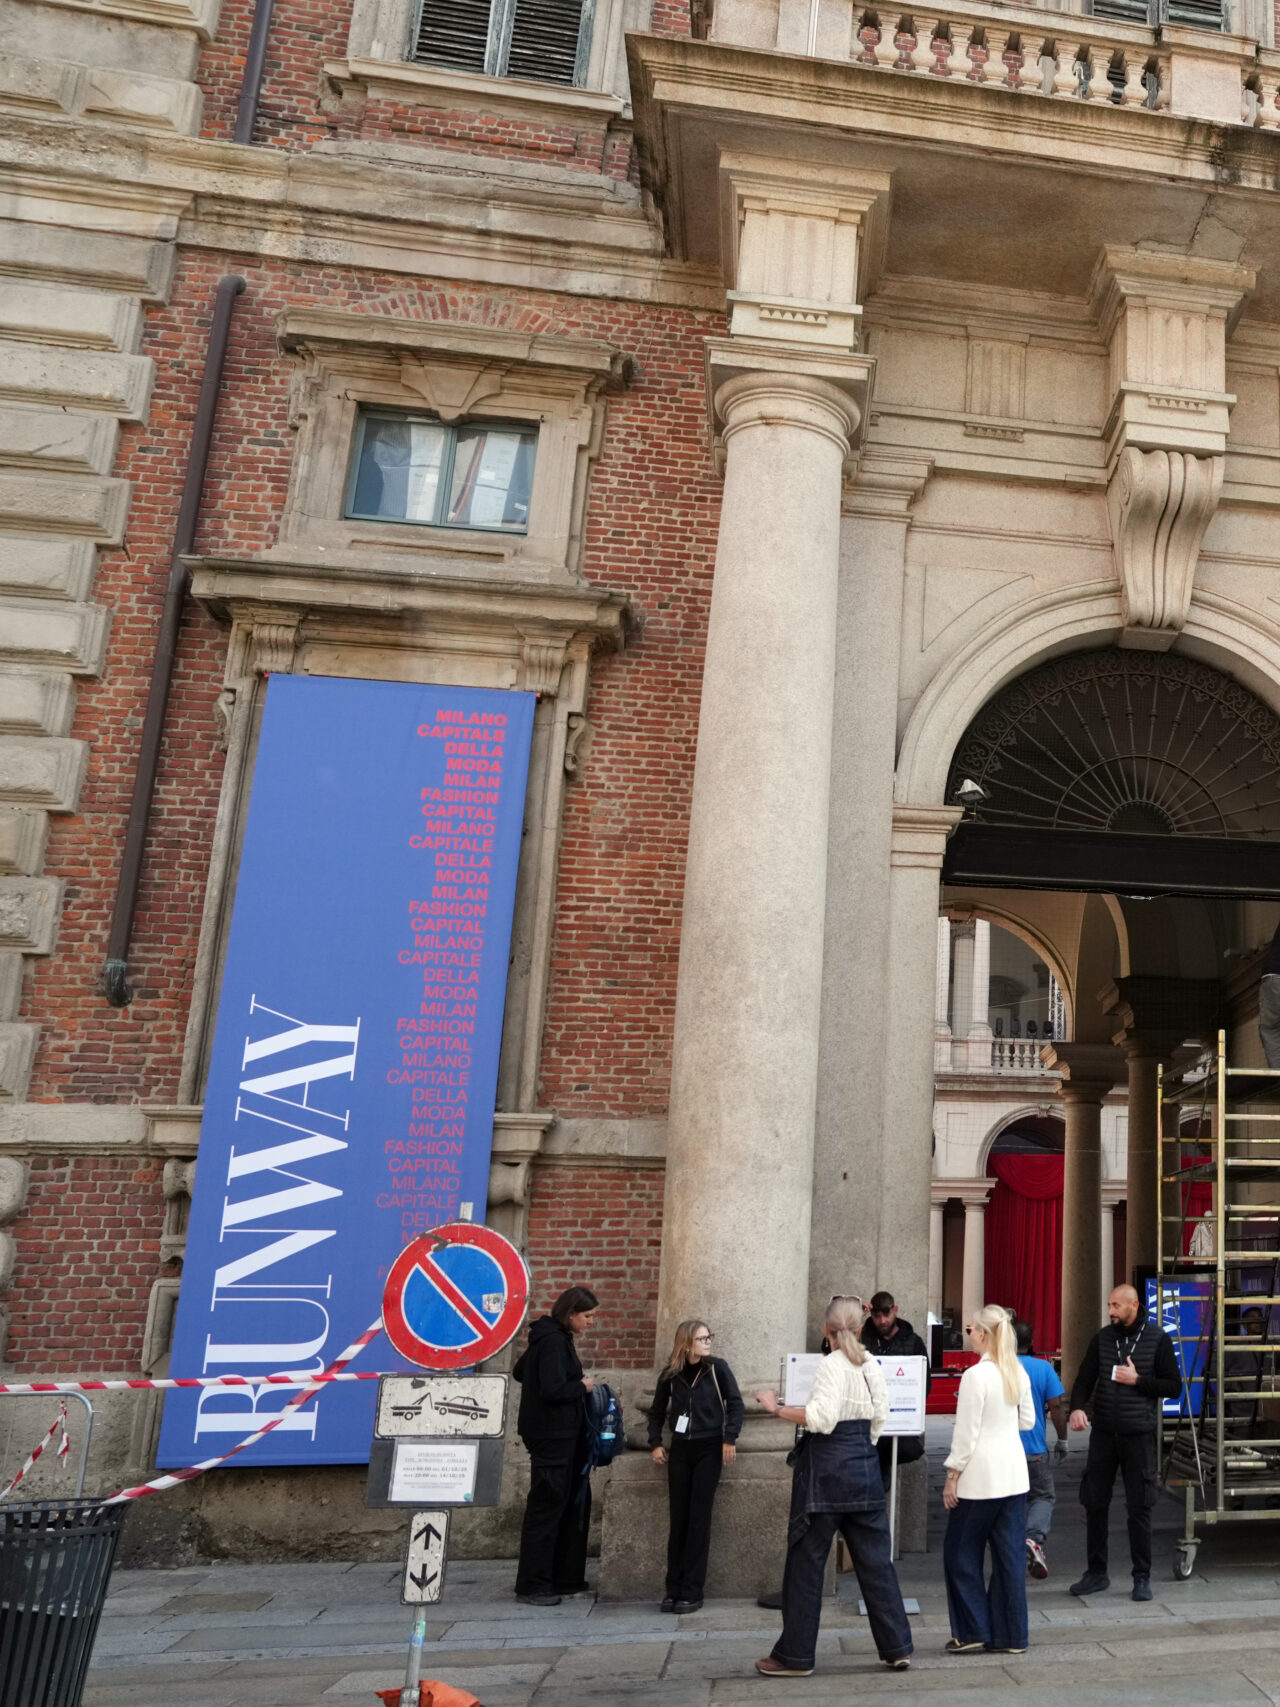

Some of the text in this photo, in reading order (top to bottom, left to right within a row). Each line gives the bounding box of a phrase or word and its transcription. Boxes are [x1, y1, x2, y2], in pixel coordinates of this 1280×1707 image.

[436, 710, 507, 726] MILANO
[418, 725, 506, 742] CAPITALE
[445, 742, 504, 757] DELLA
[447, 758, 502, 773] MODA
[444, 774, 500, 788] MILAN
[421, 788, 499, 804] FASHION
[422, 805, 496, 820] CAPITAL
[426, 821, 495, 836] MILANO
[409, 836, 494, 852] CAPITALE
[435, 853, 492, 868] DELLA
[436, 870, 490, 884] MODA
[432, 886, 488, 900] MILAN
[409, 901, 487, 917] FASHION
[411, 918, 485, 933] CAPITAL
[415, 935, 483, 950] MILANO
[398, 951, 482, 967] CAPITALE
[424, 969, 480, 984] DELLA
[424, 985, 478, 1000] MODA
[421, 1003, 477, 1017] MILAN
[397, 1019, 474, 1034] FASHION
[400, 1036, 472, 1051] CAPITAL
[403, 1053, 471, 1068] MILANO
[387, 1070, 470, 1086] CAPITALE
[412, 1088, 468, 1103] DELLA
[412, 1105, 466, 1120] MODA
[409, 1123, 464, 1137] MILAN
[385, 1140, 463, 1155] FASHION
[389, 1158, 461, 1173] CAPITAL
[392, 1177, 460, 1191] MILANO
[376, 1193, 459, 1209] CAPITALE
[193, 993, 361, 1444] RUNWAY
